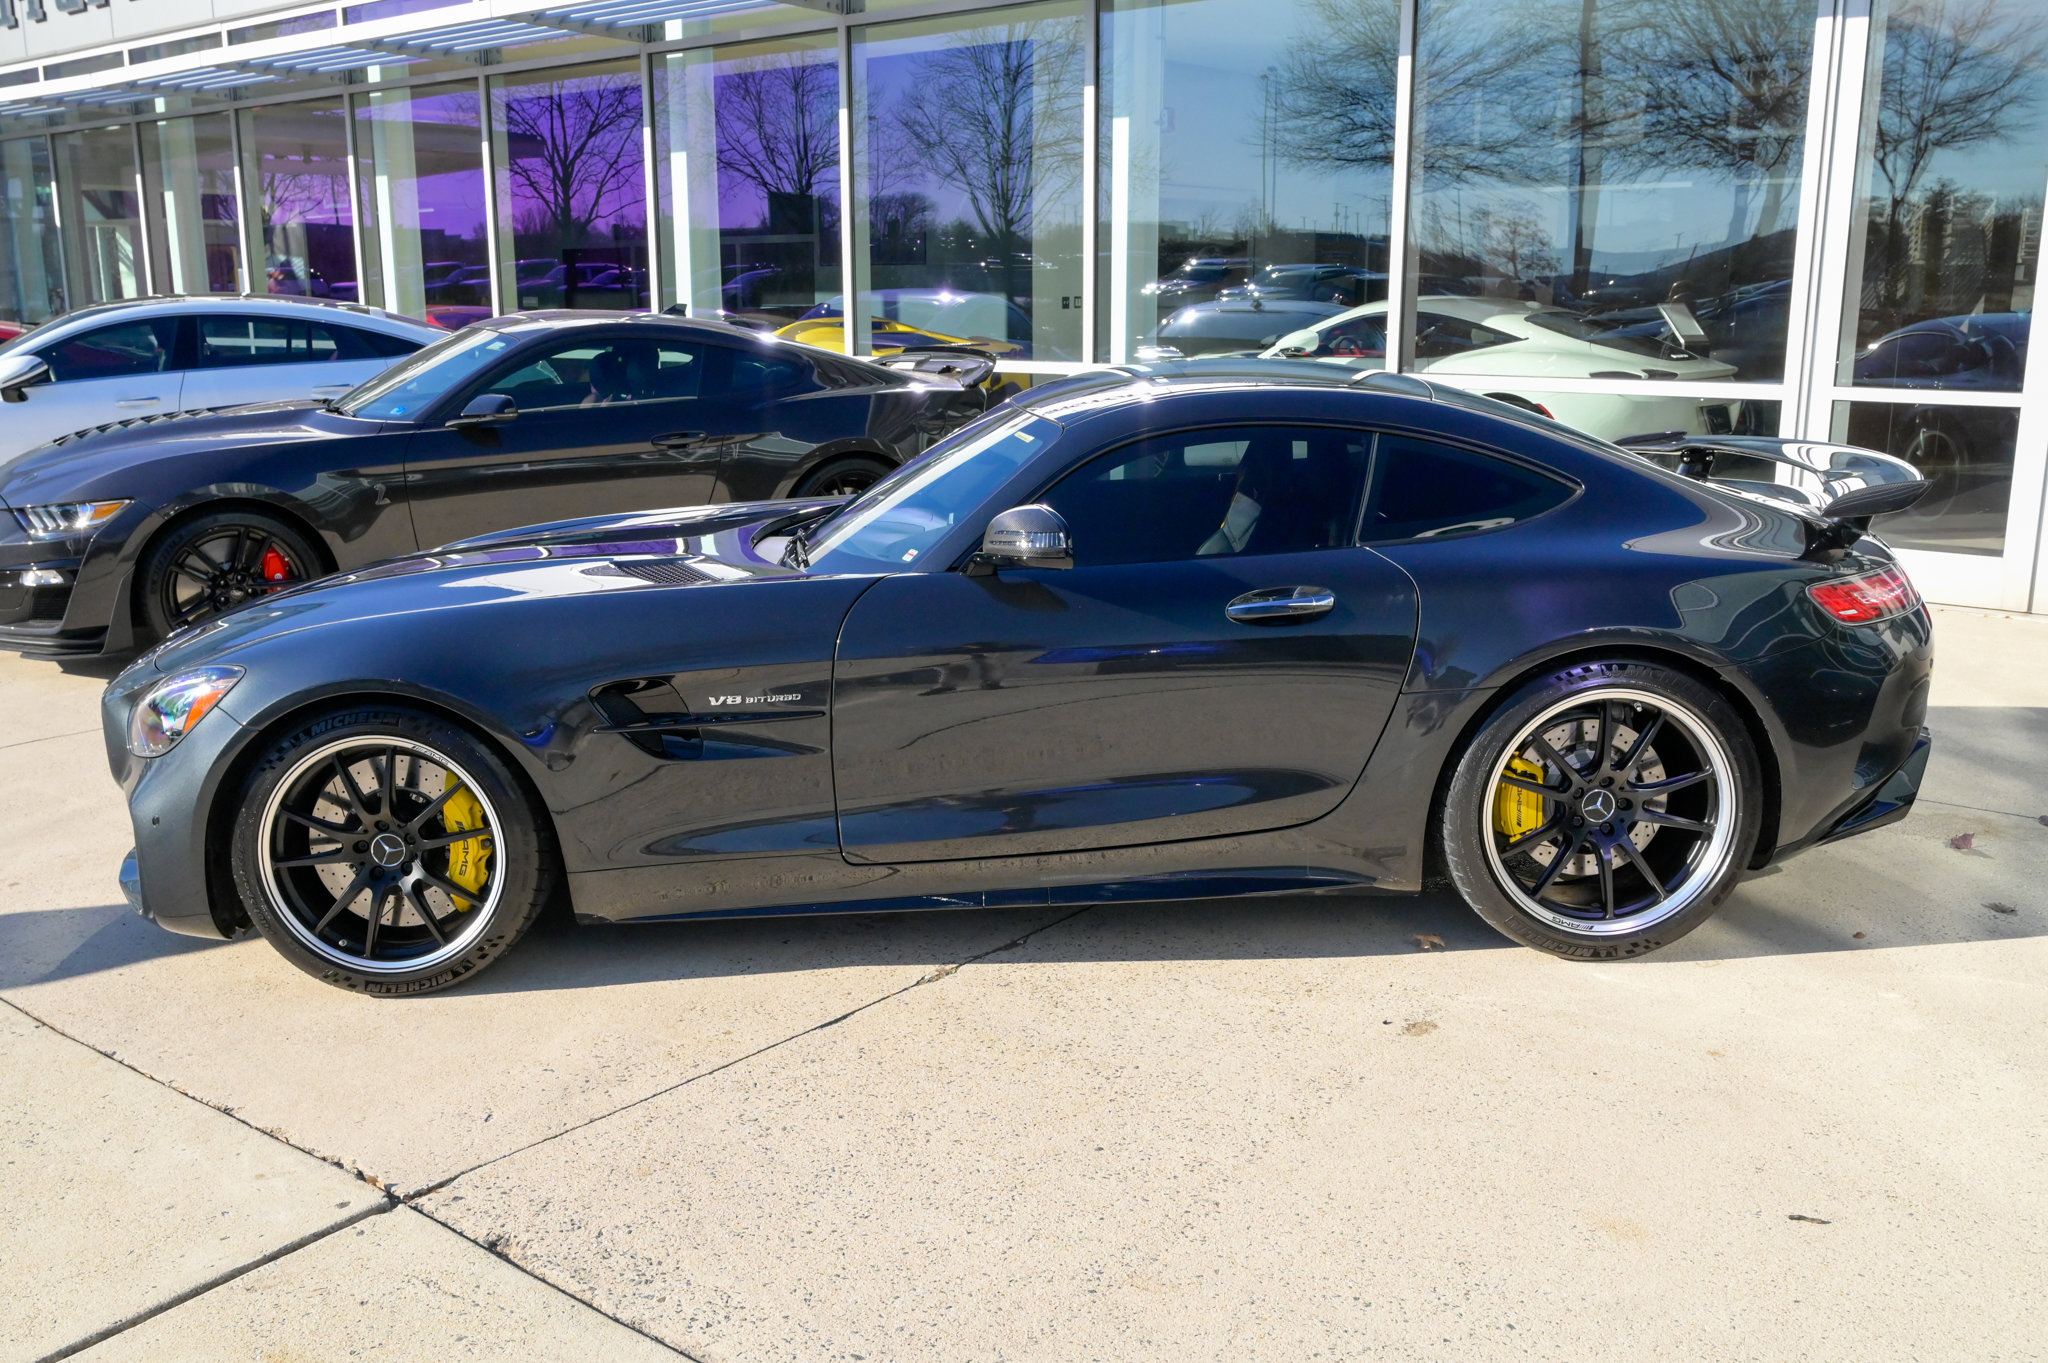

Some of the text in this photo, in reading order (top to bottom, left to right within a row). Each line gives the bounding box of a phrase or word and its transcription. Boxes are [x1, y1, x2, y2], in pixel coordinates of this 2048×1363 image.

[708, 693, 801, 706] V8 BITURBO
[458, 839, 470, 877] AMG
[366, 971, 453, 993] MICHELIN
